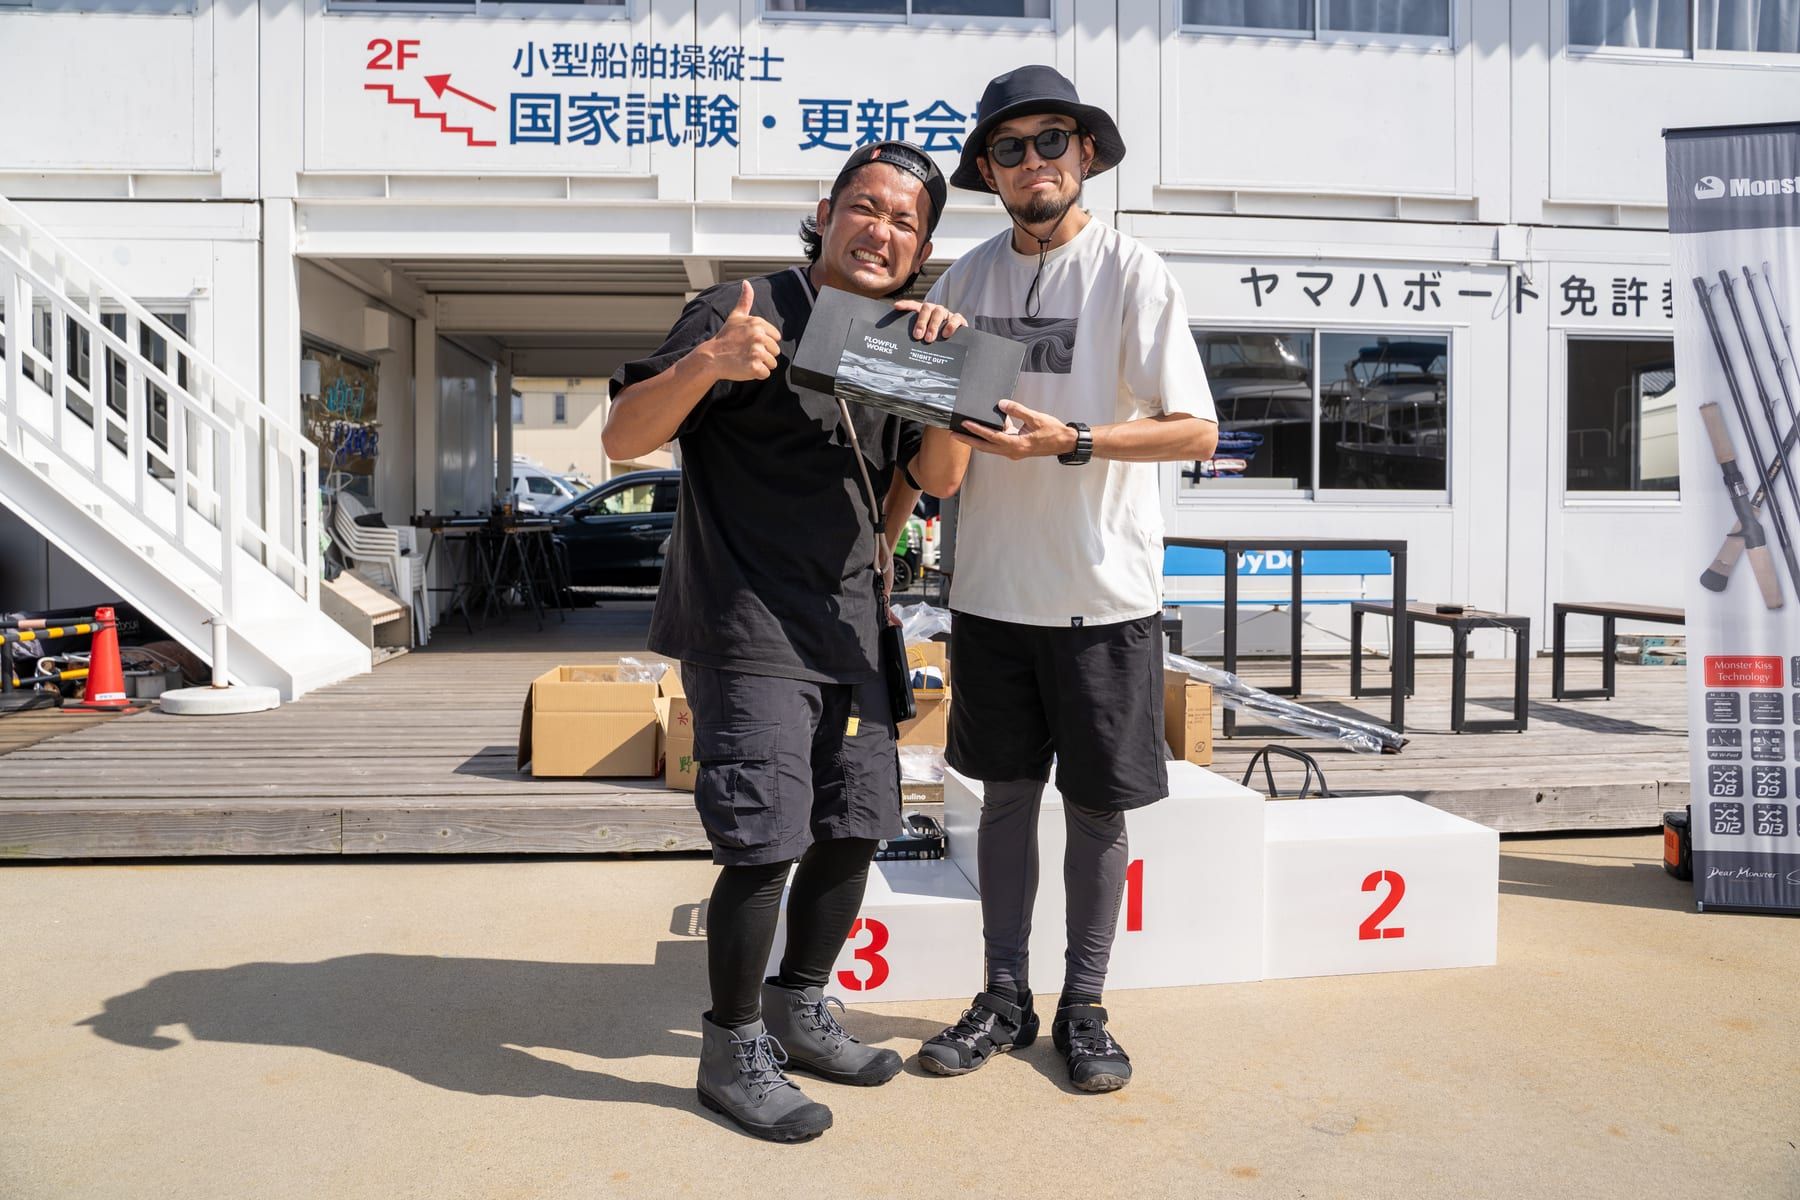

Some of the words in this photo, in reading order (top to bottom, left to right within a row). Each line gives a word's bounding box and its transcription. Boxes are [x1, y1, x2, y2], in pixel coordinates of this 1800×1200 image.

[366, 38, 421, 70] 2F
[512, 41, 785, 81] 小型船舶操縦士
[510, 91, 981, 153] 国家試験・更新会
[864, 335, 899, 350] FLOWFUL
[866, 342, 893, 354] WORKS
[1714, 661, 1752, 670] Monster
[1754, 661, 1773, 670] Kiss
[1718, 672, 1770, 684] Technology
[1713, 784, 1737, 795] D8
[1757, 785, 1780, 797] D9
[1714, 821, 1741, 833] D12
[1758, 822, 1784, 835] D13
[1126, 860, 1144, 931] 1
[1359, 870, 1406, 940] 2
[837, 918, 890, 991] 3
